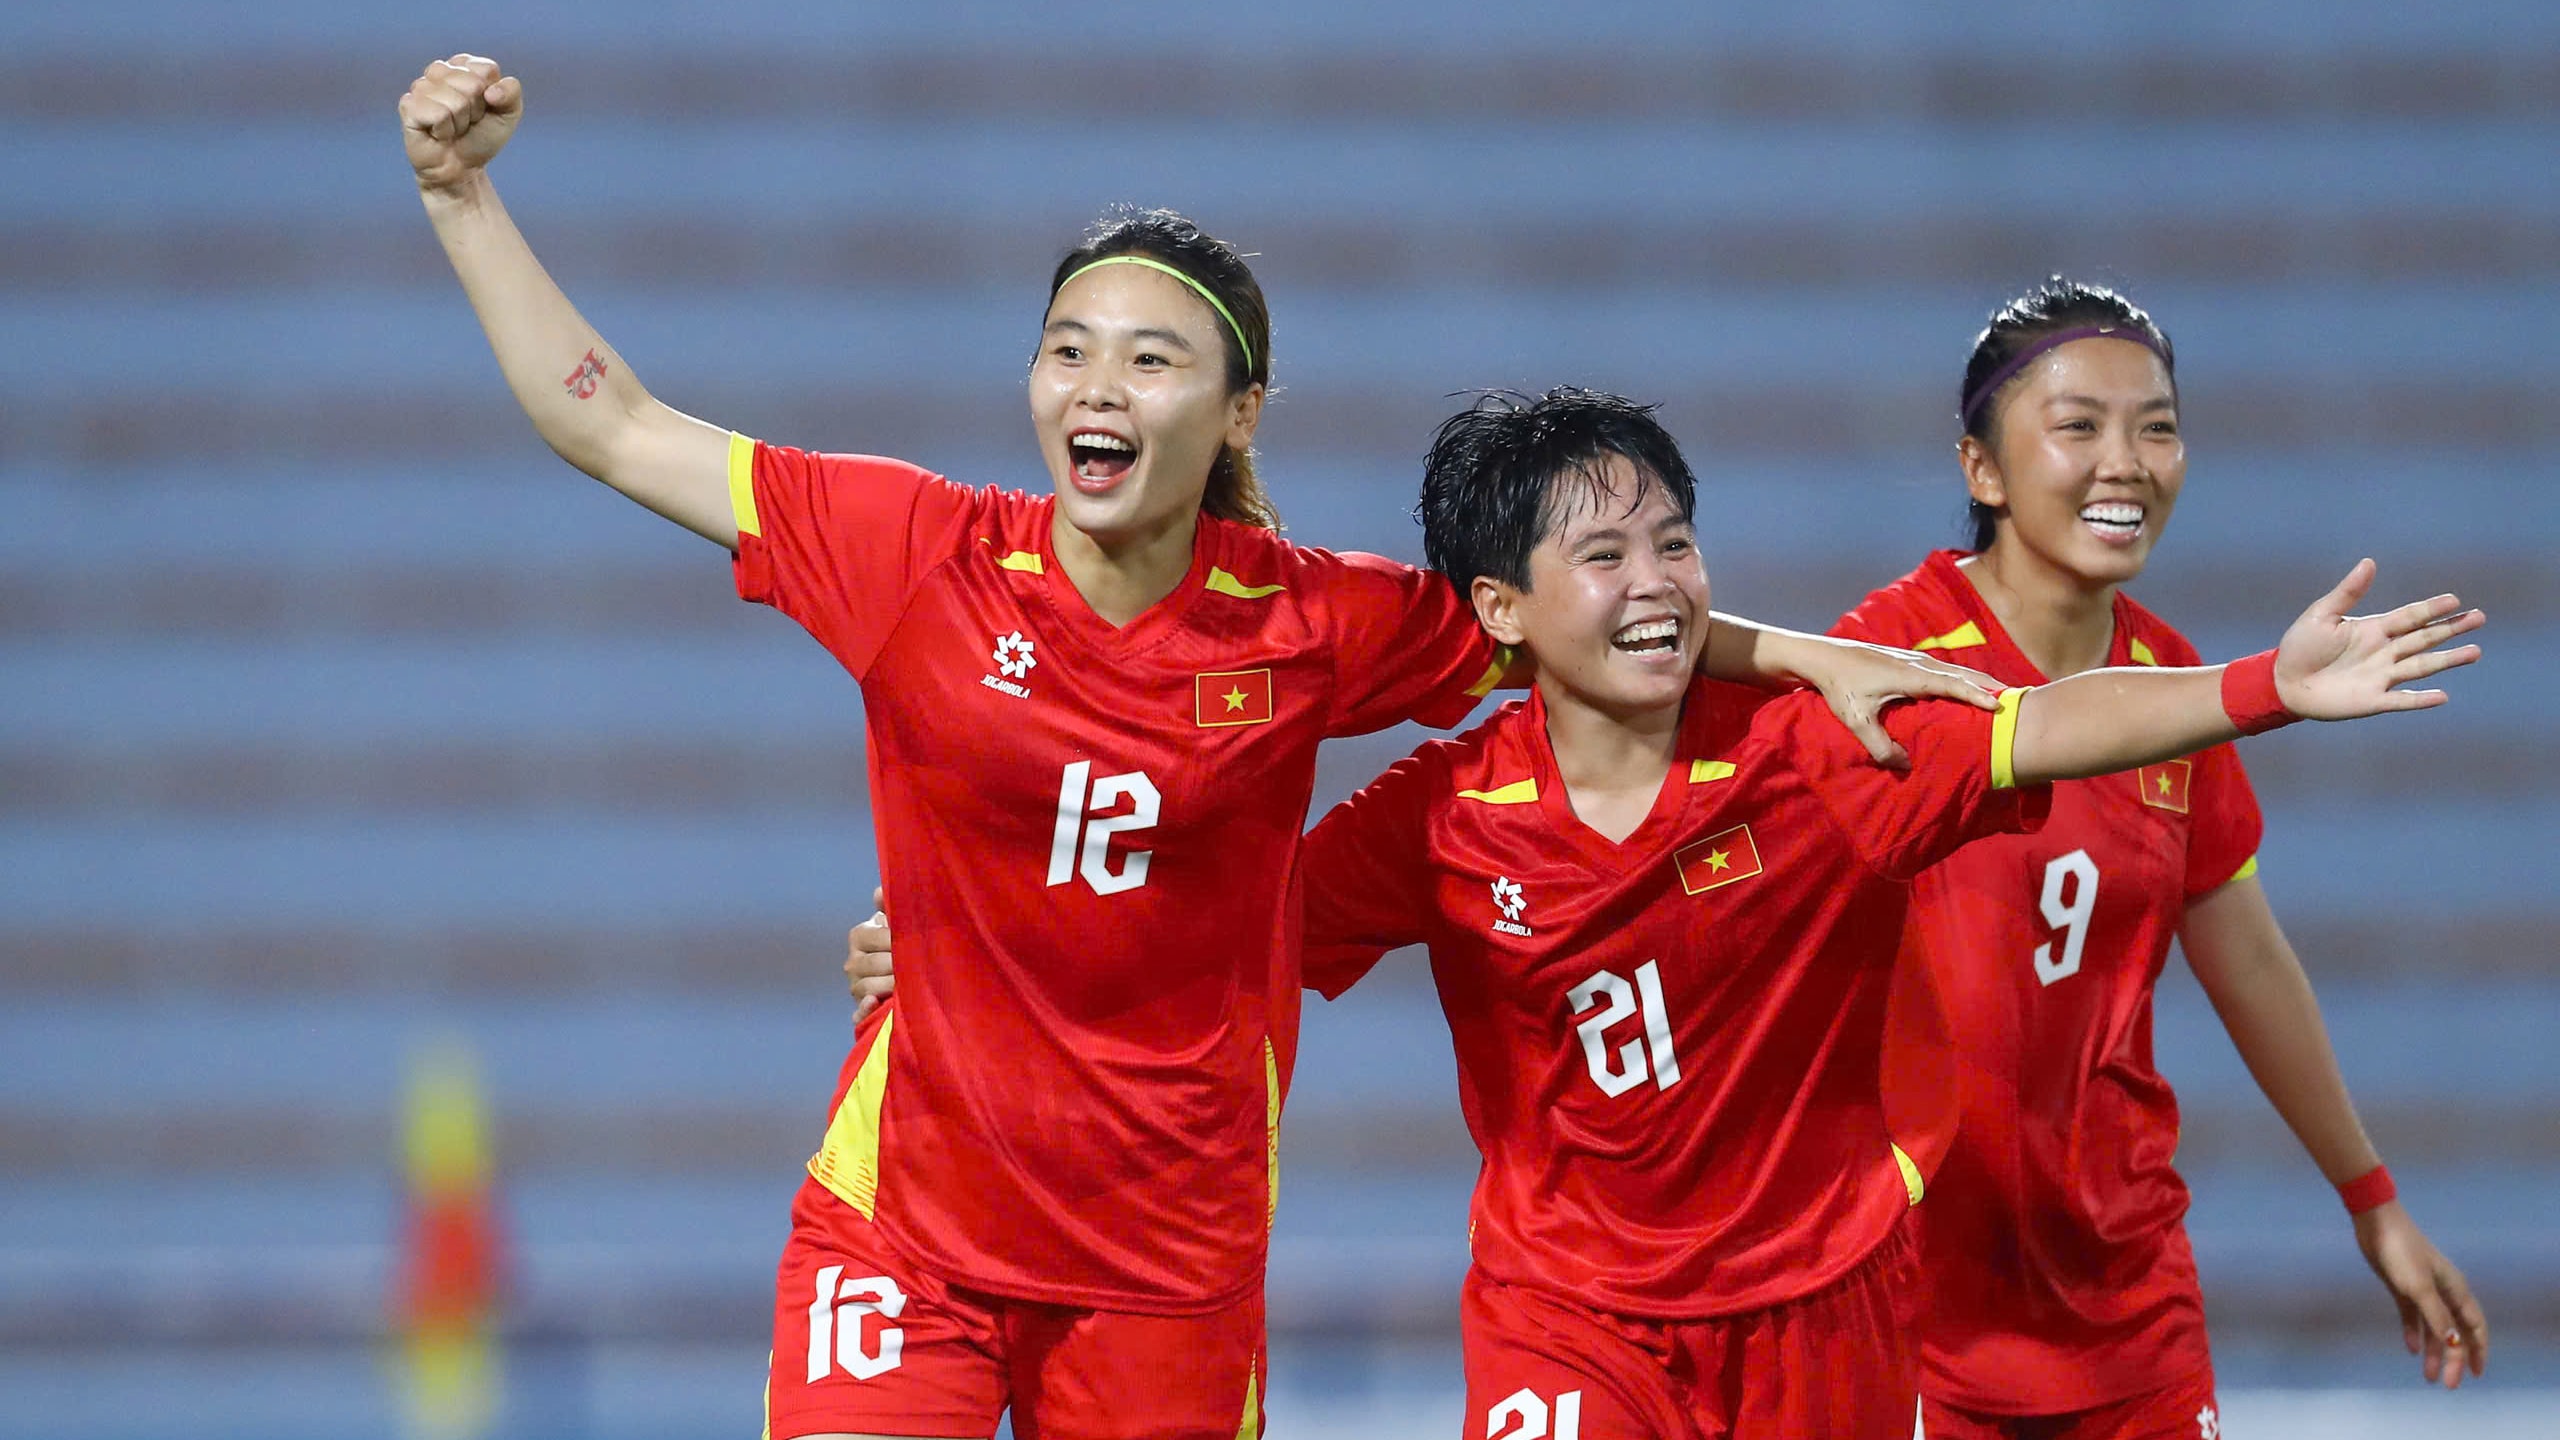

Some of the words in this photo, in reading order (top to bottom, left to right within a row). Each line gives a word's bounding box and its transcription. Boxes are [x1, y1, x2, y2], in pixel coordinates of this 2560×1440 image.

[1046, 760, 1162, 896] 12
[2033, 848, 2100, 987] 9
[1566, 959, 1682, 1099] 21
[806, 1264, 908, 1385] 12
